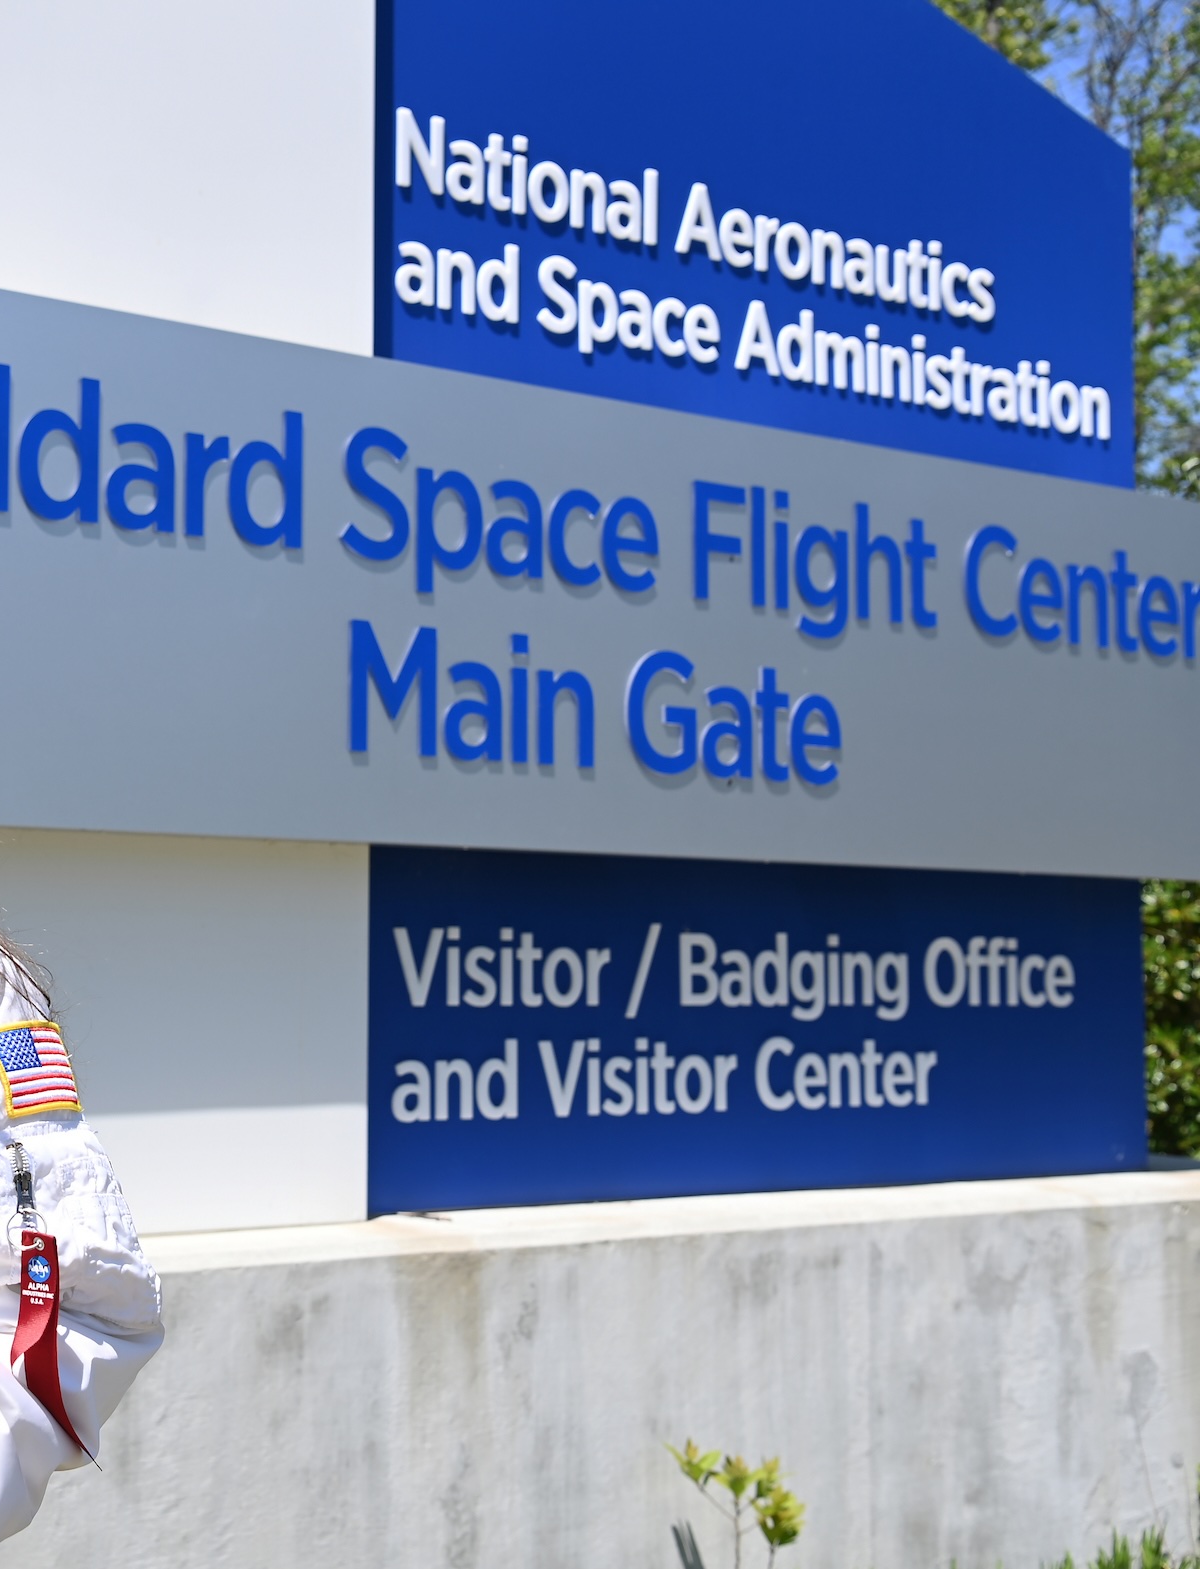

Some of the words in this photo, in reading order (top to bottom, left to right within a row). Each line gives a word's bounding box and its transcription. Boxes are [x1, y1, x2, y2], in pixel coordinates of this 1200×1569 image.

[395, 106, 659, 247] National
[675, 181, 996, 324] Aeronautics
[394, 240, 520, 325] and
[536, 254, 721, 355] Space
[734, 299, 1111, 440] Administration
[341, 427, 659, 593] Space
[693, 480, 937, 639] Flight
[965, 525, 1200, 659] Center
[350, 619, 595, 768] Main
[627, 651, 842, 785] Gate
[393, 925, 611, 1008] Visitor
[625, 923, 662, 1019] /
[678, 931, 909, 1021] Badging
[923, 936, 1076, 1008] Office
[391, 1038, 519, 1123] and
[538, 1037, 738, 1118] Visitor
[755, 1036, 937, 1111] Center
[28, 1282, 49, 1291] ALPHA
